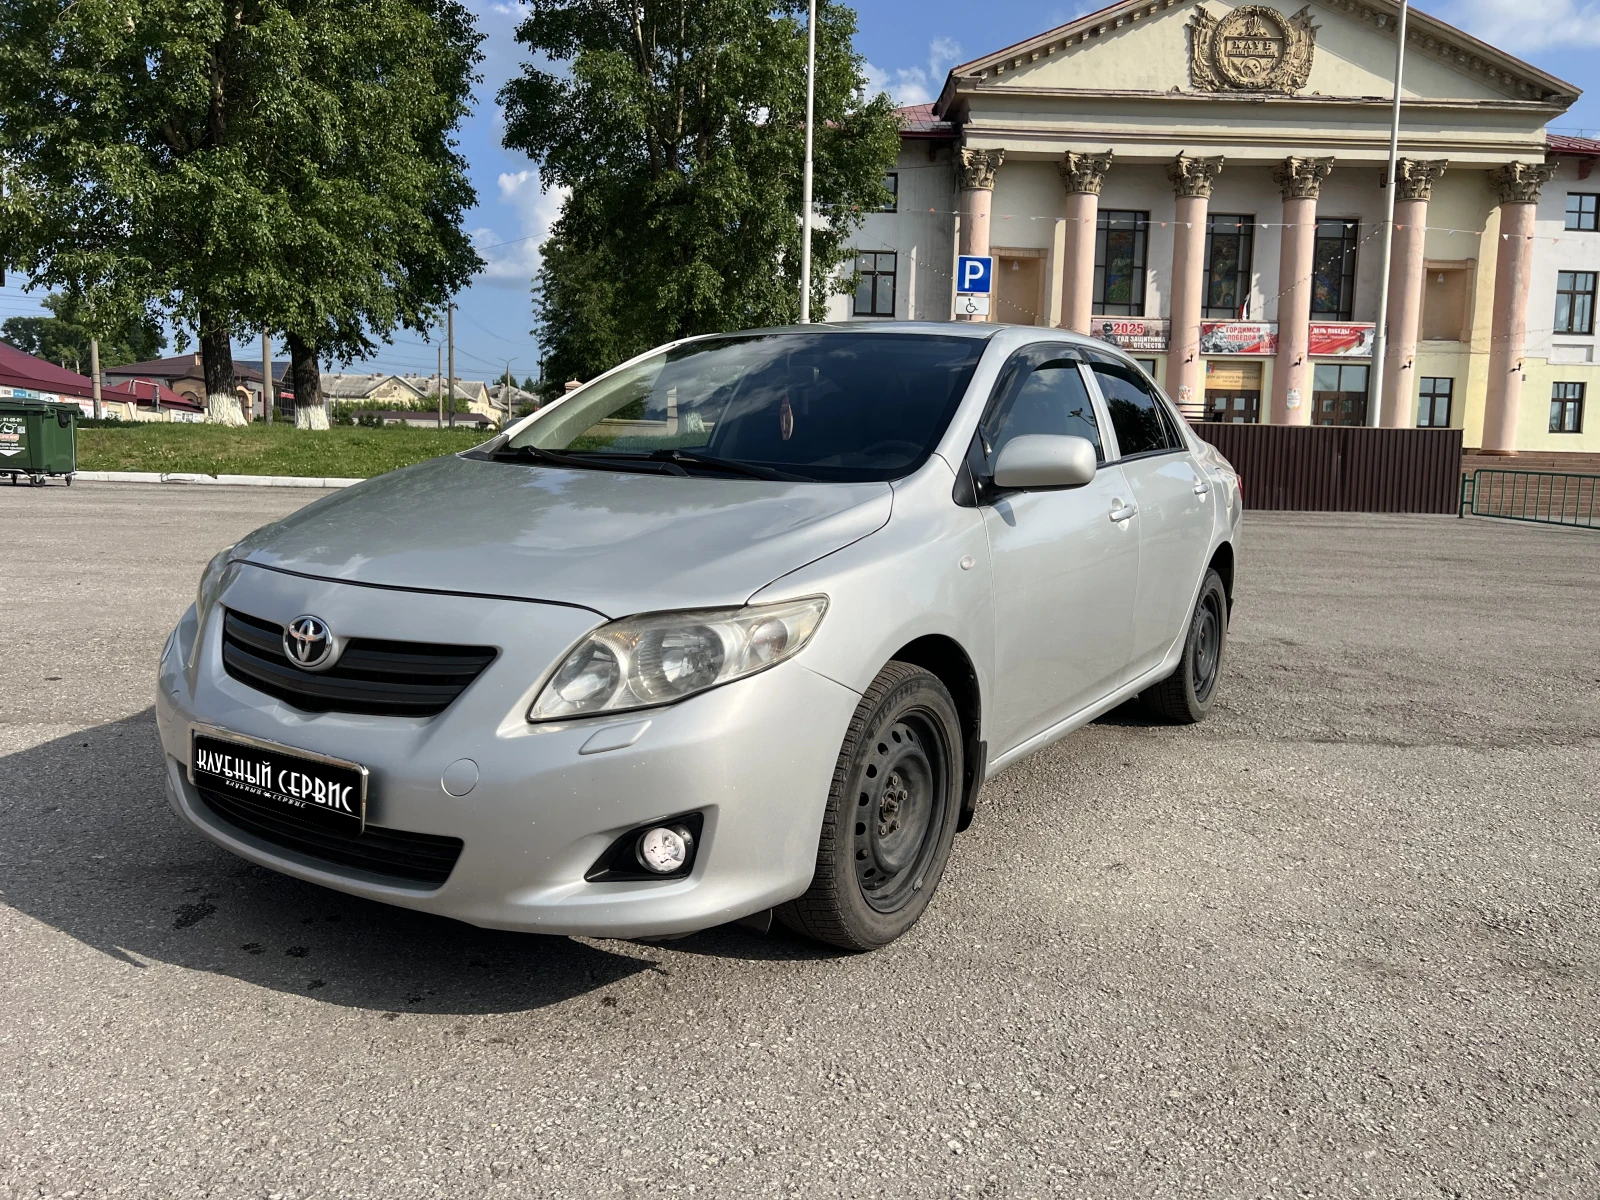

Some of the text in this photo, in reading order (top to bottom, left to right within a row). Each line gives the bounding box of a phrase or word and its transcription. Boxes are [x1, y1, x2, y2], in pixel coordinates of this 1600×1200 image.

[964, 260, 985, 289] P
[1113, 323, 1145, 335] 2025
[1225, 326, 1261, 334] ГОРДИМСЯ
